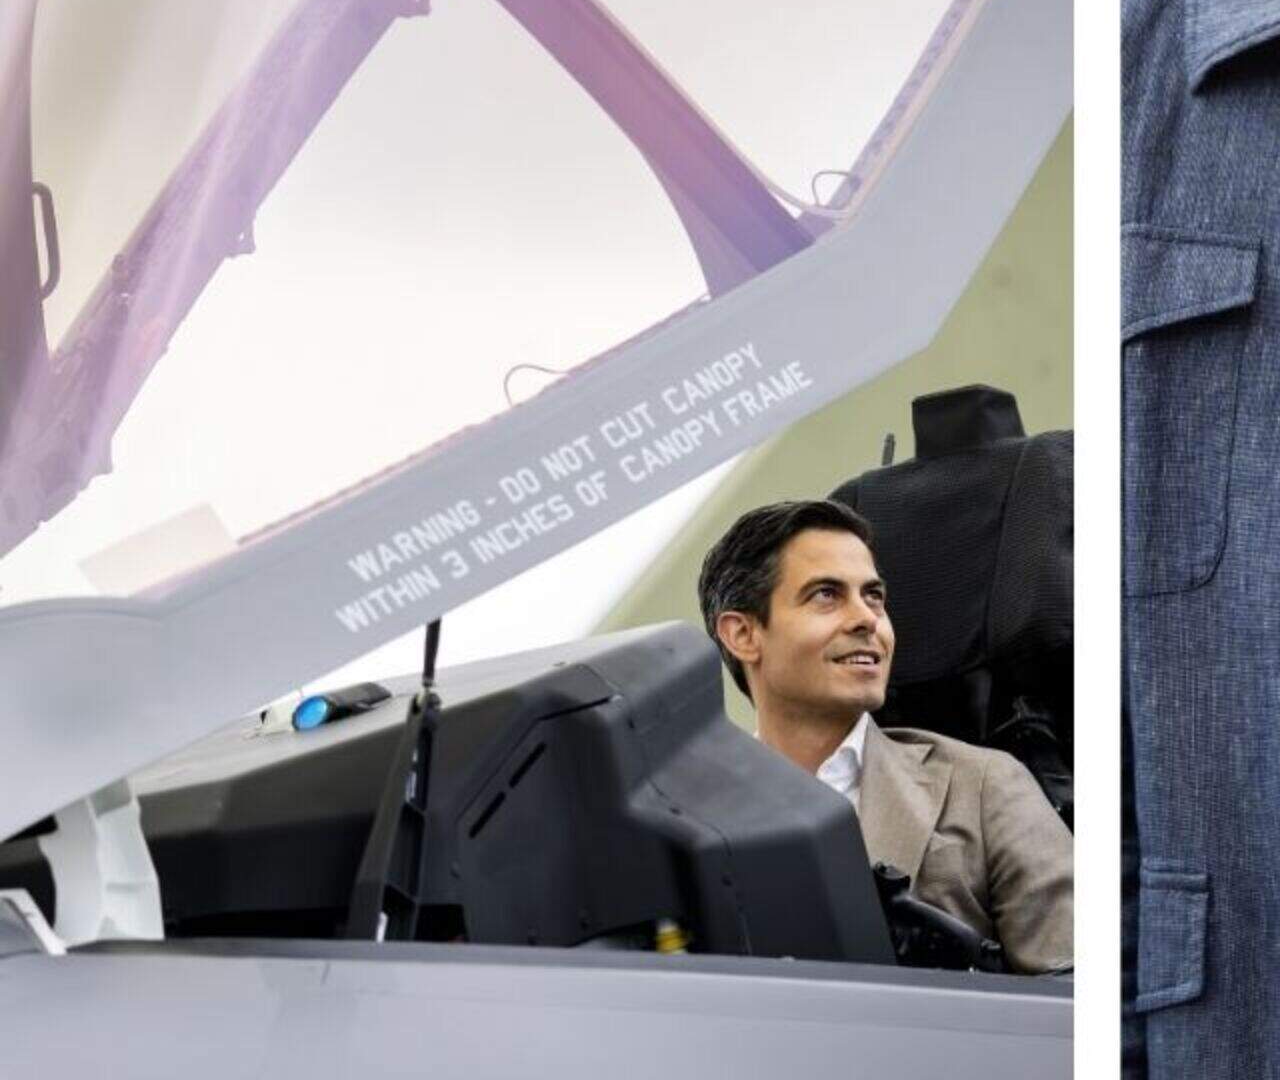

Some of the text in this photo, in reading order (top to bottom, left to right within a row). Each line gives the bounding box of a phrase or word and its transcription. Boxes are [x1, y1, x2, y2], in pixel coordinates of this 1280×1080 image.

[335, 360, 814, 635] WITHIN 3 INCHES OF CANOPY FRAME
[347, 496, 482, 583] WARNING
[498, 466, 542, 506] DO
[541, 437, 597, 481] NOT
[600, 402, 654, 450] CUT
[662, 342, 764, 414] CANOPY
